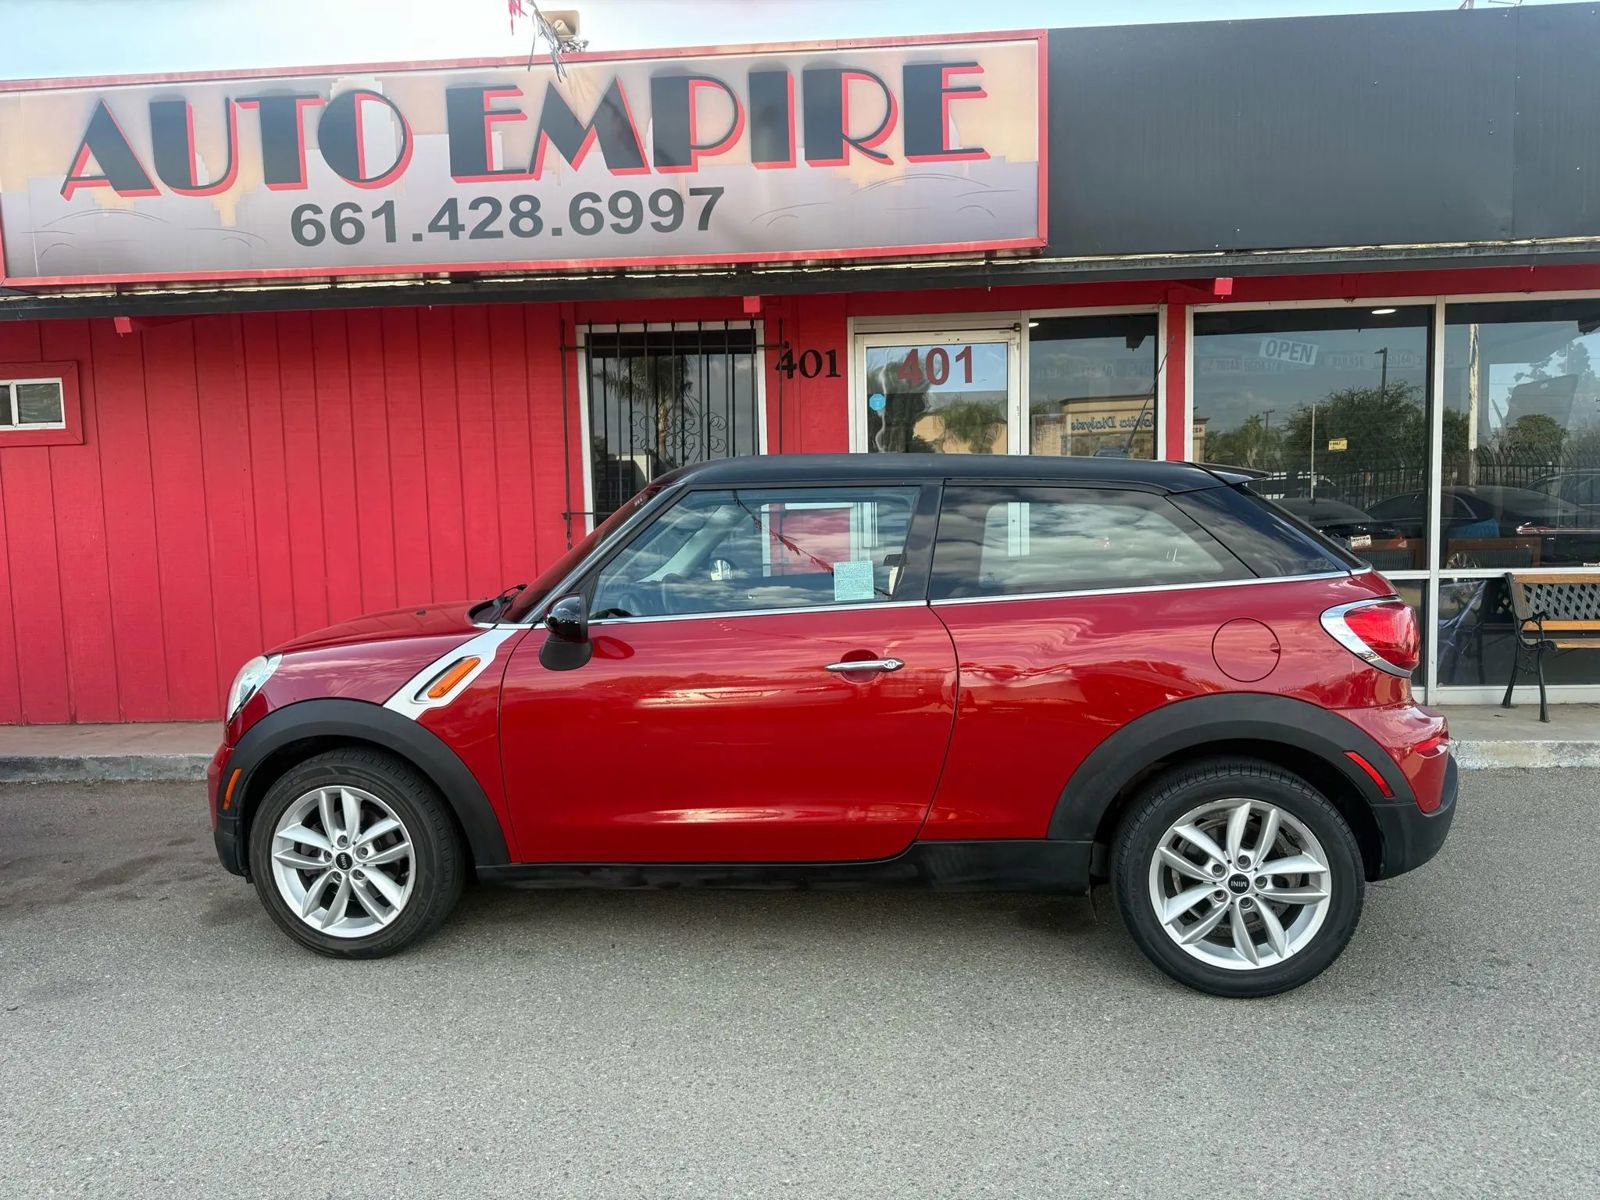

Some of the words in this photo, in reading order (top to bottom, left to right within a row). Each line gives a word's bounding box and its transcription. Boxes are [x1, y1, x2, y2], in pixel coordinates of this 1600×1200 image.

[60, 88, 414, 202] AUTO
[446, 60, 991, 183] EMPIRE
[290, 186, 725, 247] 661.428.6997
[775, 347, 841, 379] 401
[897, 346, 973, 385] 401
[1265, 340, 1313, 363] OPEN
[1230, 880, 1247, 888] MINI
